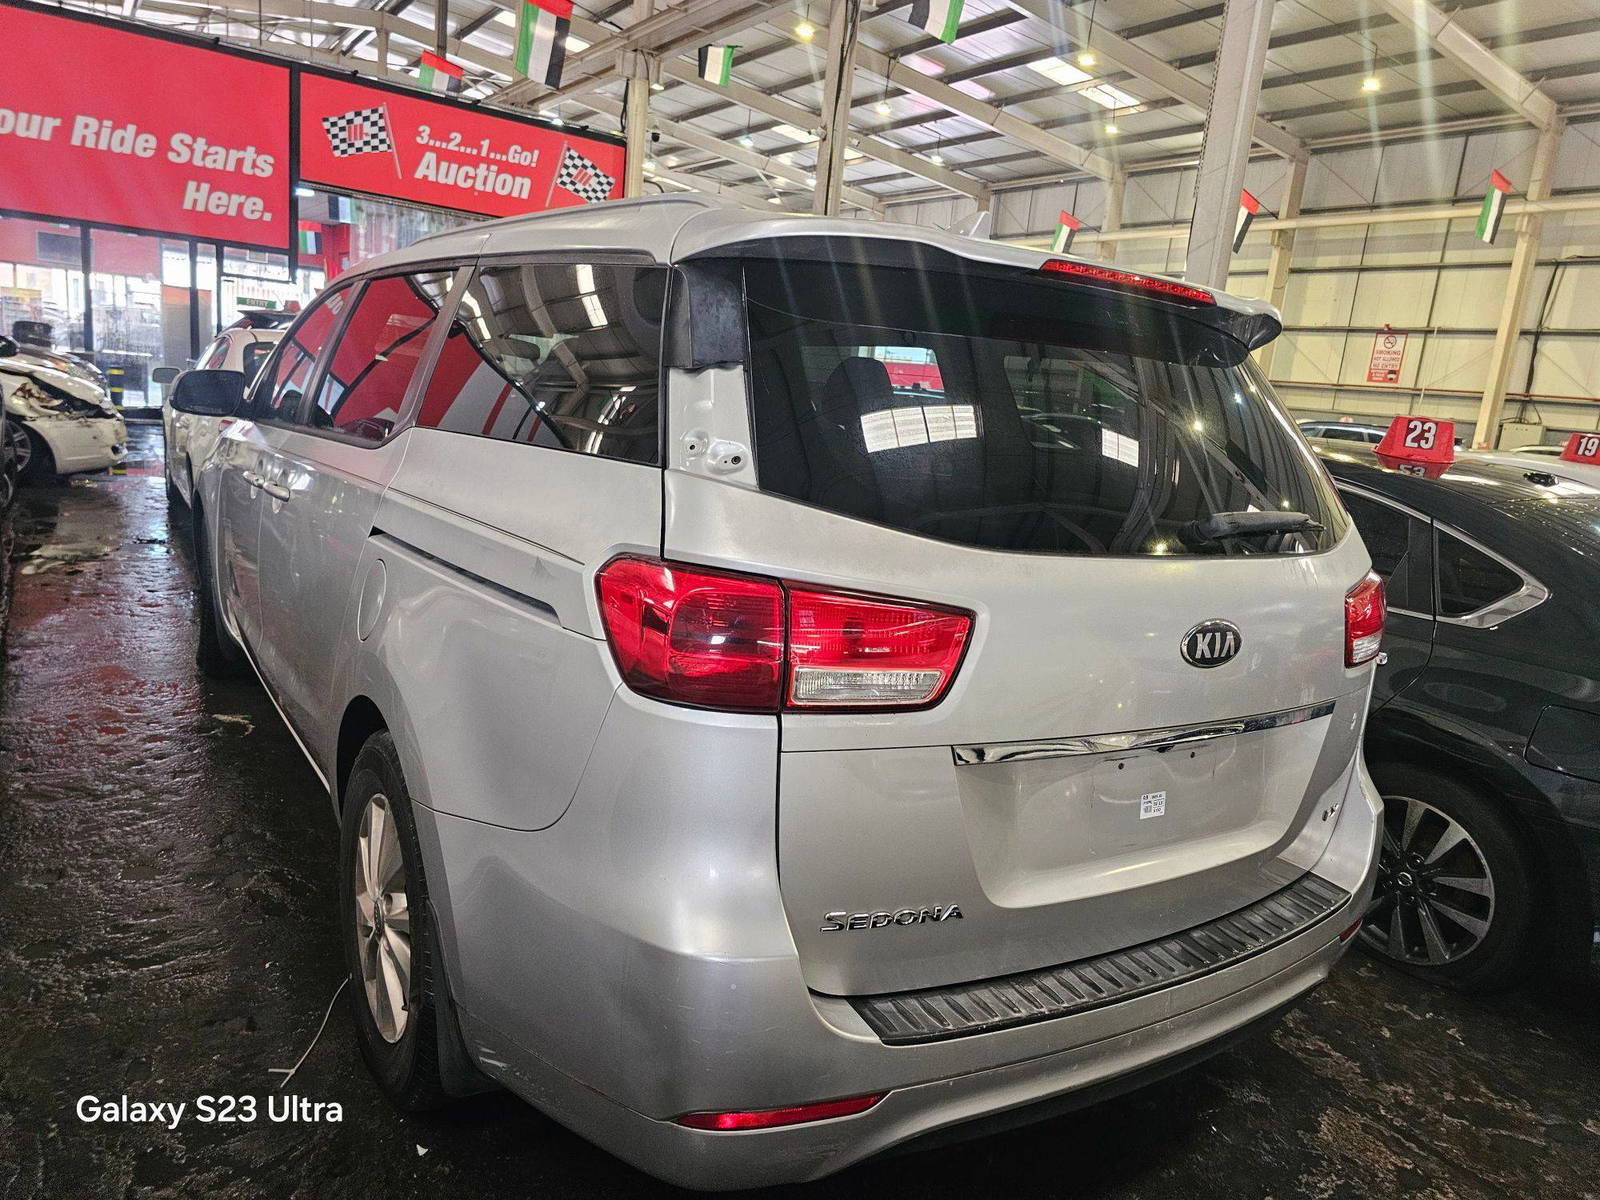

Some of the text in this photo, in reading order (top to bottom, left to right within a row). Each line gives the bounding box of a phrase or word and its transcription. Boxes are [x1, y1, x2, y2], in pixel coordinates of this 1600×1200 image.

[70, 114, 158, 158] Ride
[167, 132, 275, 178] Starts
[413, 151, 532, 200] Auction
[182, 180, 272, 222] Here.
[1404, 420, 1437, 449] 23
[1577, 436, 1600, 457] 19
[1195, 631, 1235, 659] KIA
[820, 903, 963, 932] SEDONA
